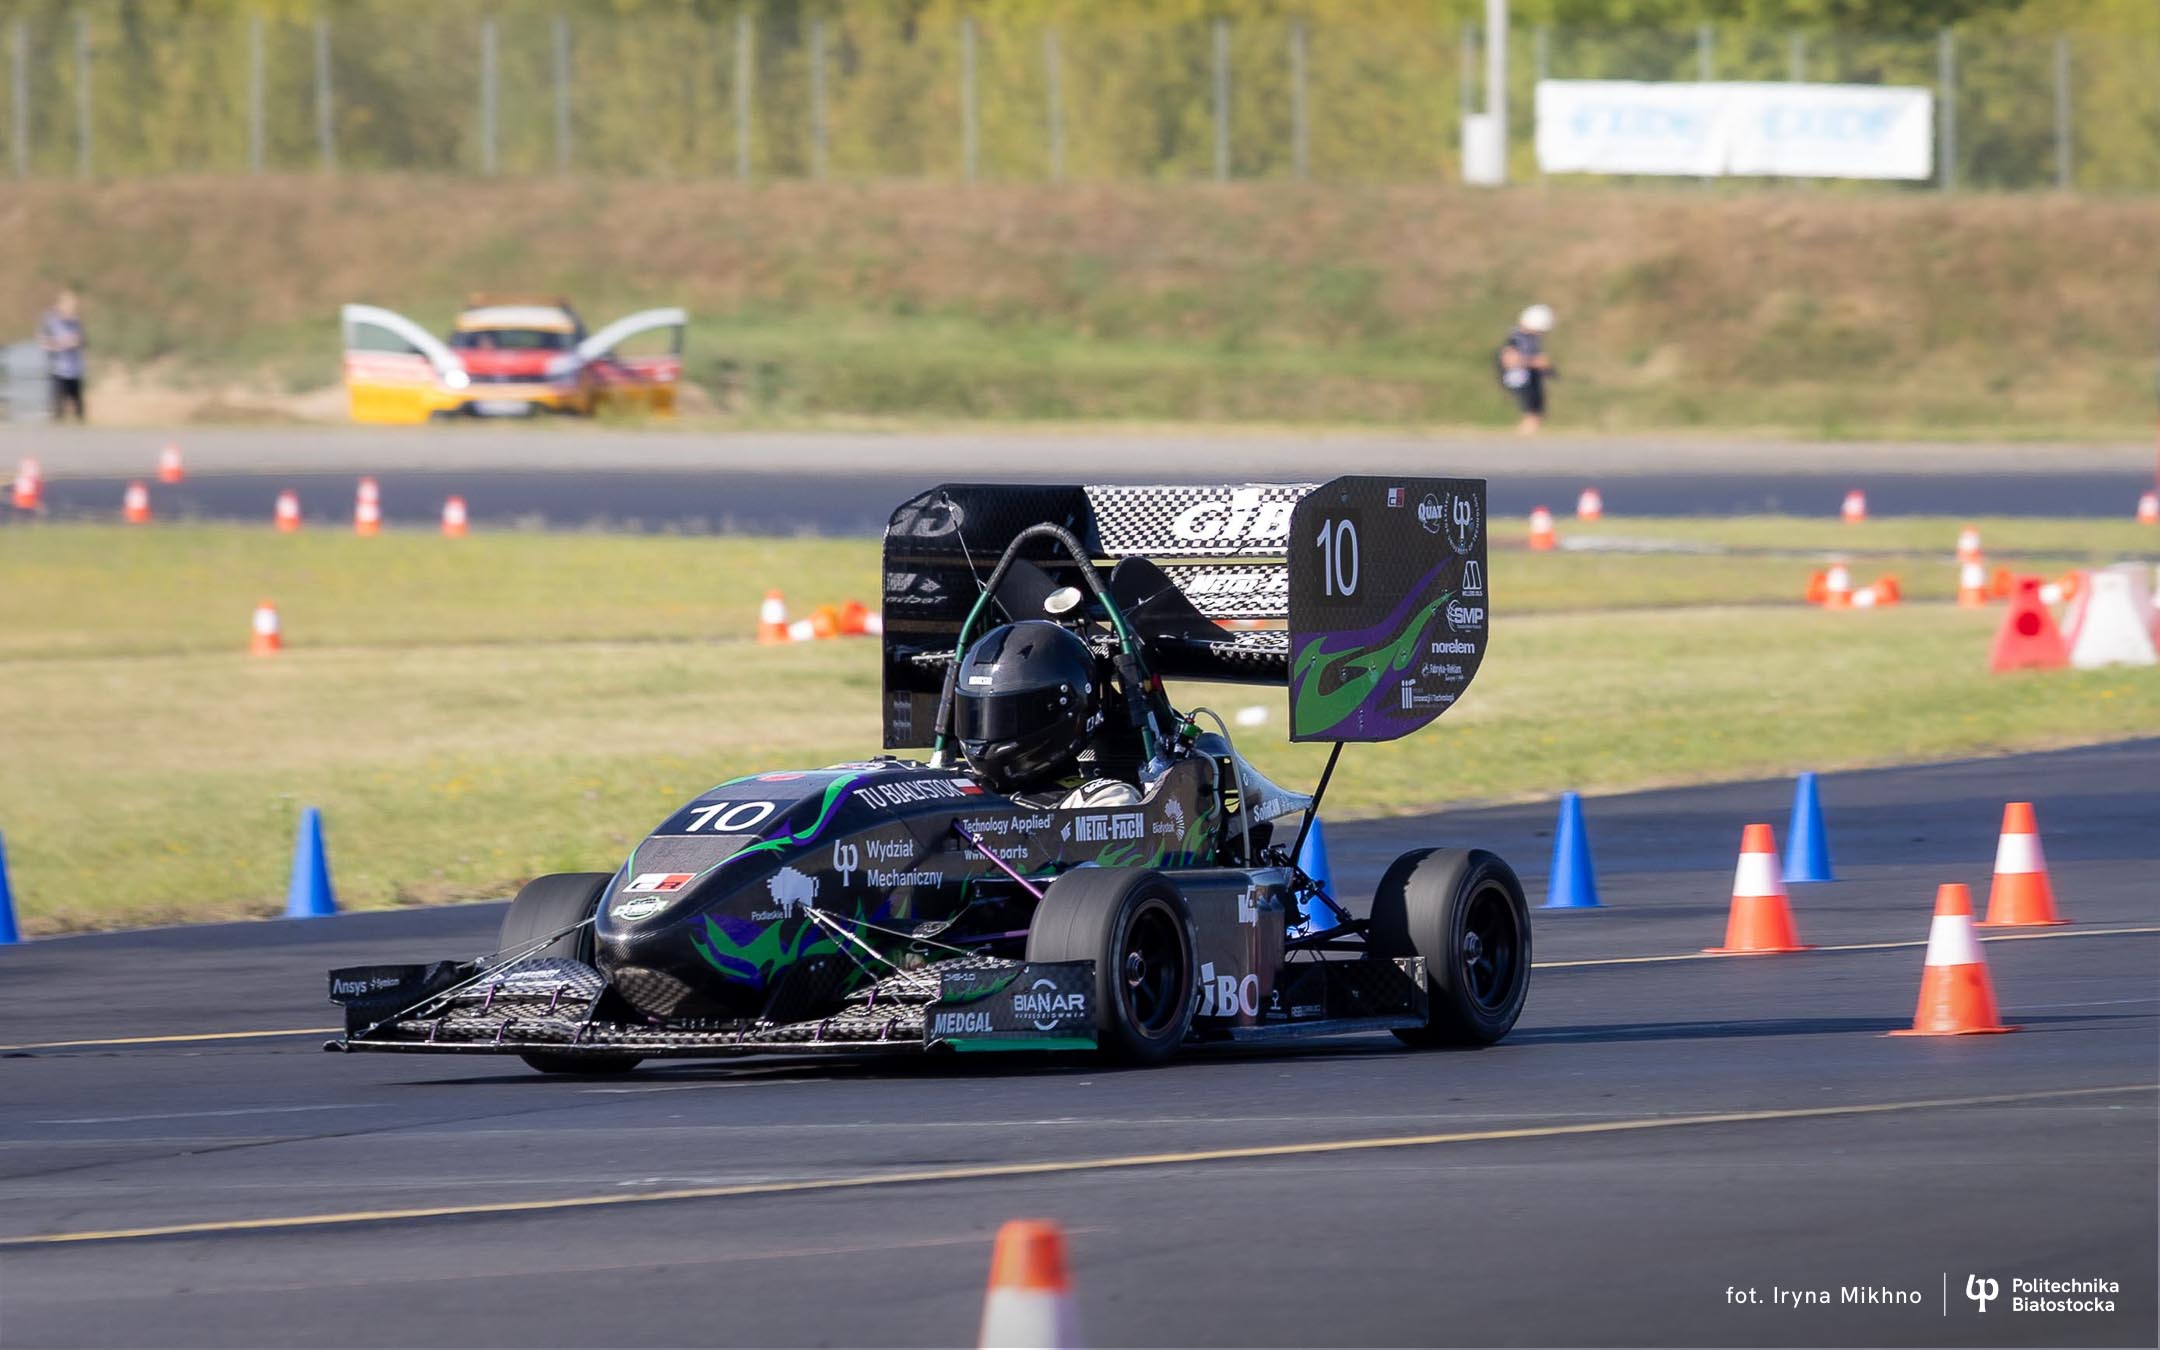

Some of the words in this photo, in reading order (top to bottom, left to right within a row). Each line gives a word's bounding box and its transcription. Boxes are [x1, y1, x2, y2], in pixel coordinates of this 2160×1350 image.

[1173, 488, 1296, 541] GiB
[1316, 519, 1359, 596] 10
[1454, 607, 1484, 624] SMP
[1431, 639, 1475, 655] norelem
[852, 788, 887, 810] TU
[685, 801, 776, 832] 10
[962, 817, 1009, 835] Technology
[1074, 813, 1145, 842] METAL-FACH
[866, 839, 914, 863] Wydział
[867, 868, 944, 890] Mechaniczny
[333, 978, 367, 996] Ansys
[1195, 961, 1259, 1017] iBO
[1014, 993, 1086, 1013] BIANAR
[934, 1012, 994, 1033] MEDGAL
